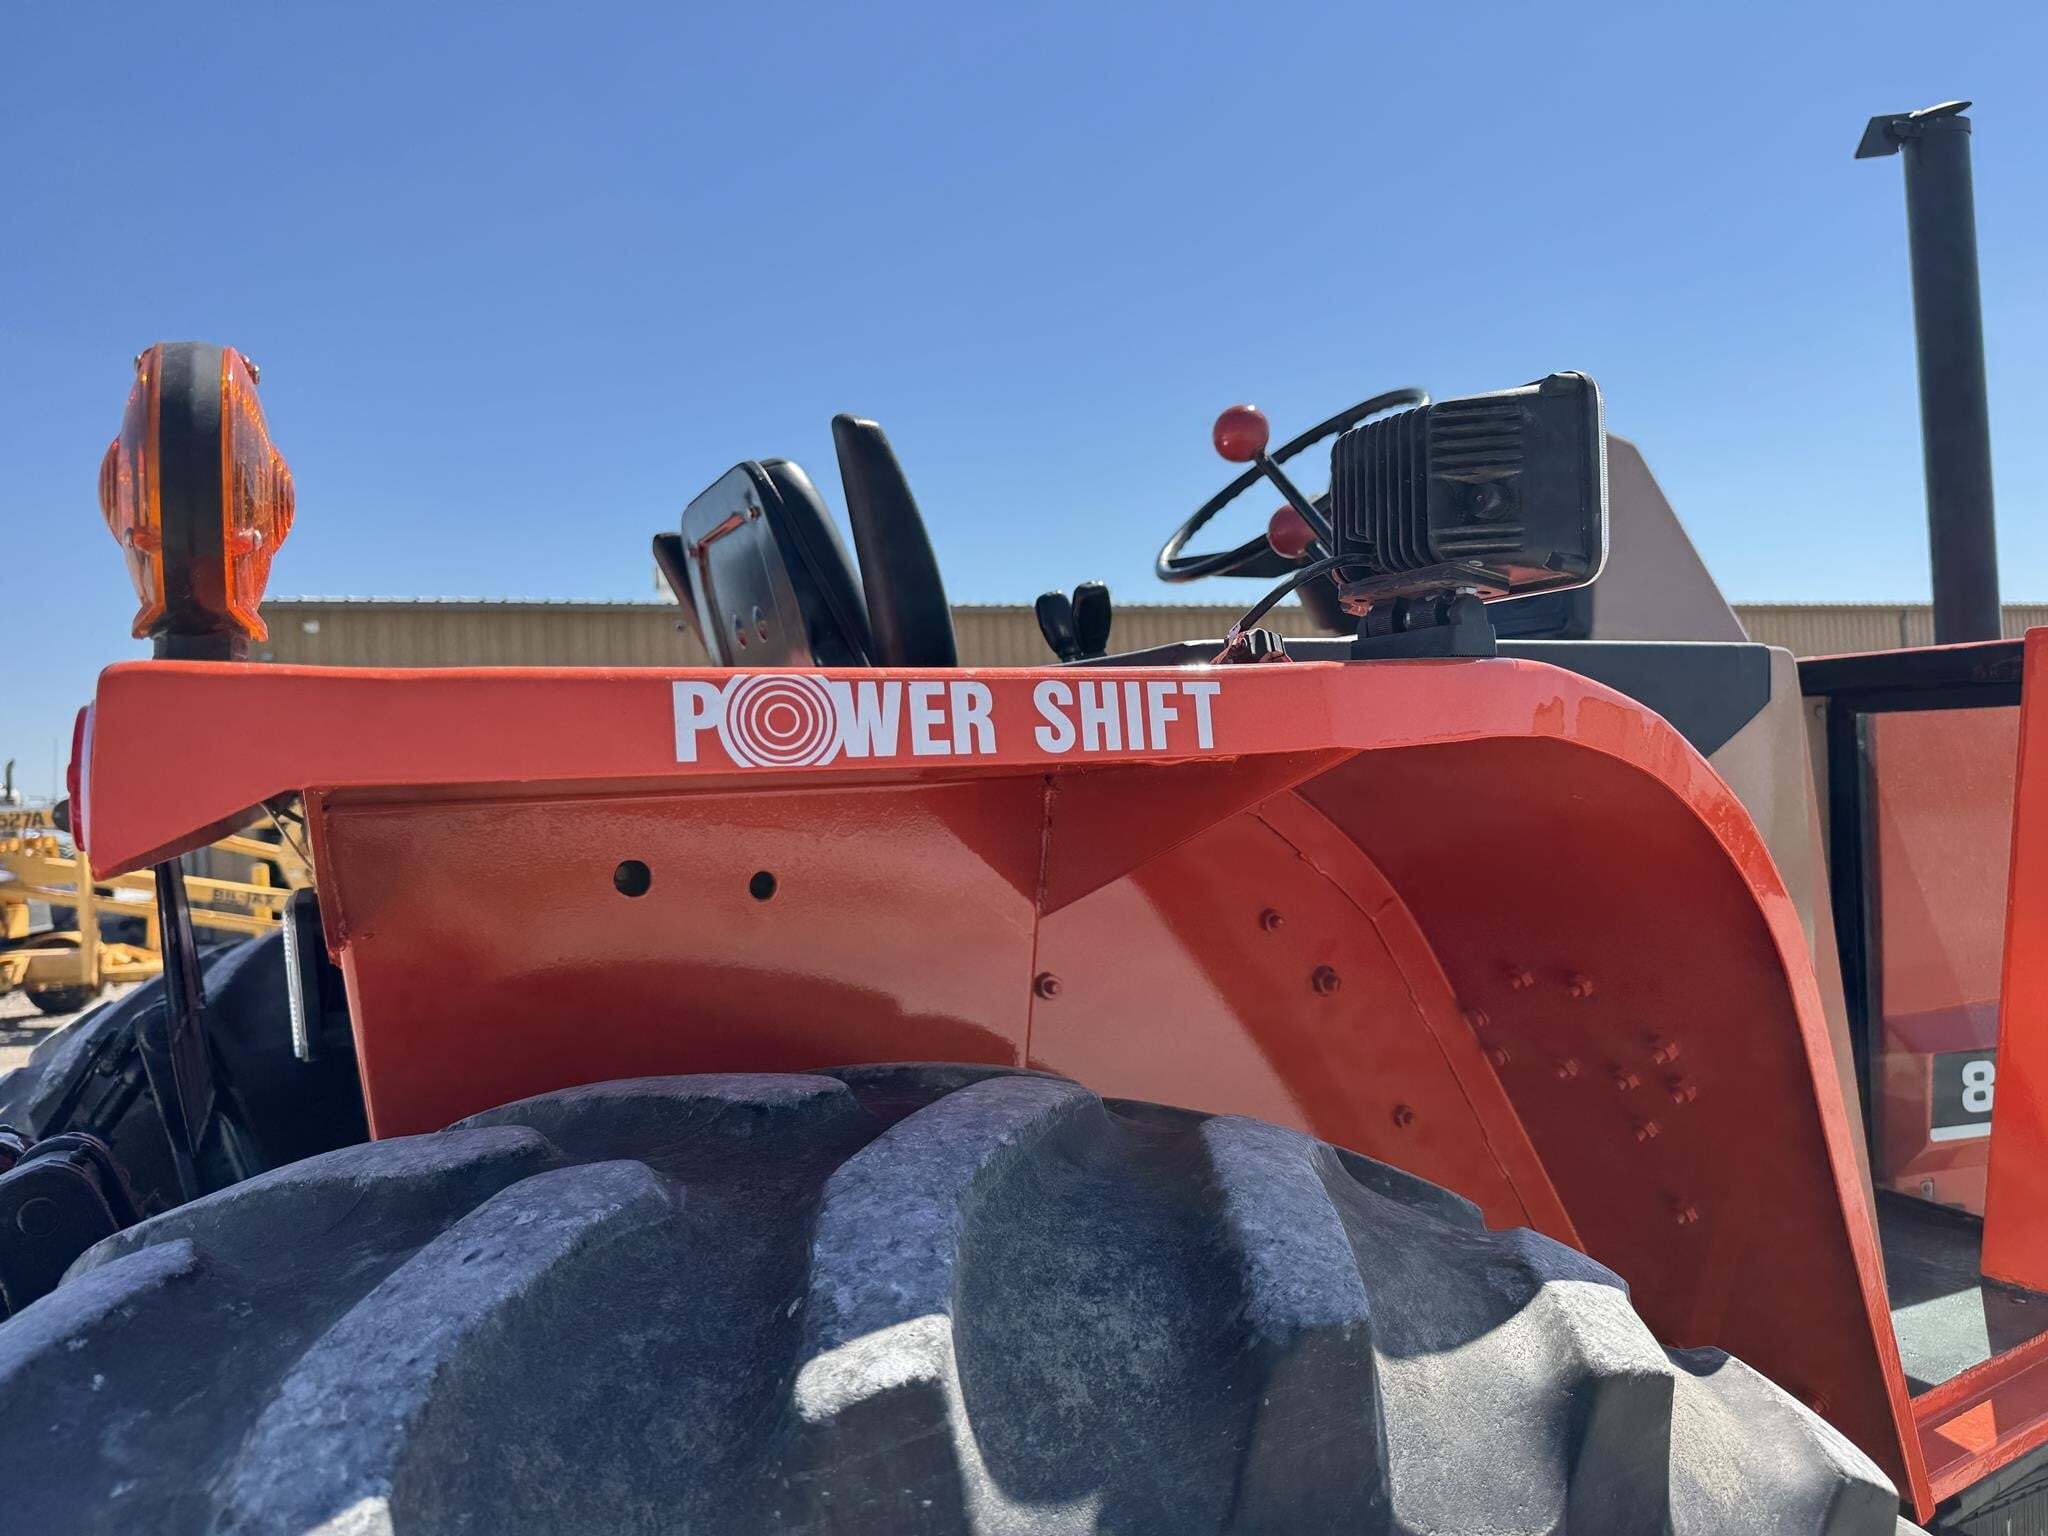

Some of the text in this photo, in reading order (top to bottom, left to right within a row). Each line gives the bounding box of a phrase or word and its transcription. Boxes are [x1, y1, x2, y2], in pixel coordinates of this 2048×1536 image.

[672, 674, 1221, 769] POWER SHIFT
[1961, 1060, 1996, 1113] 8
